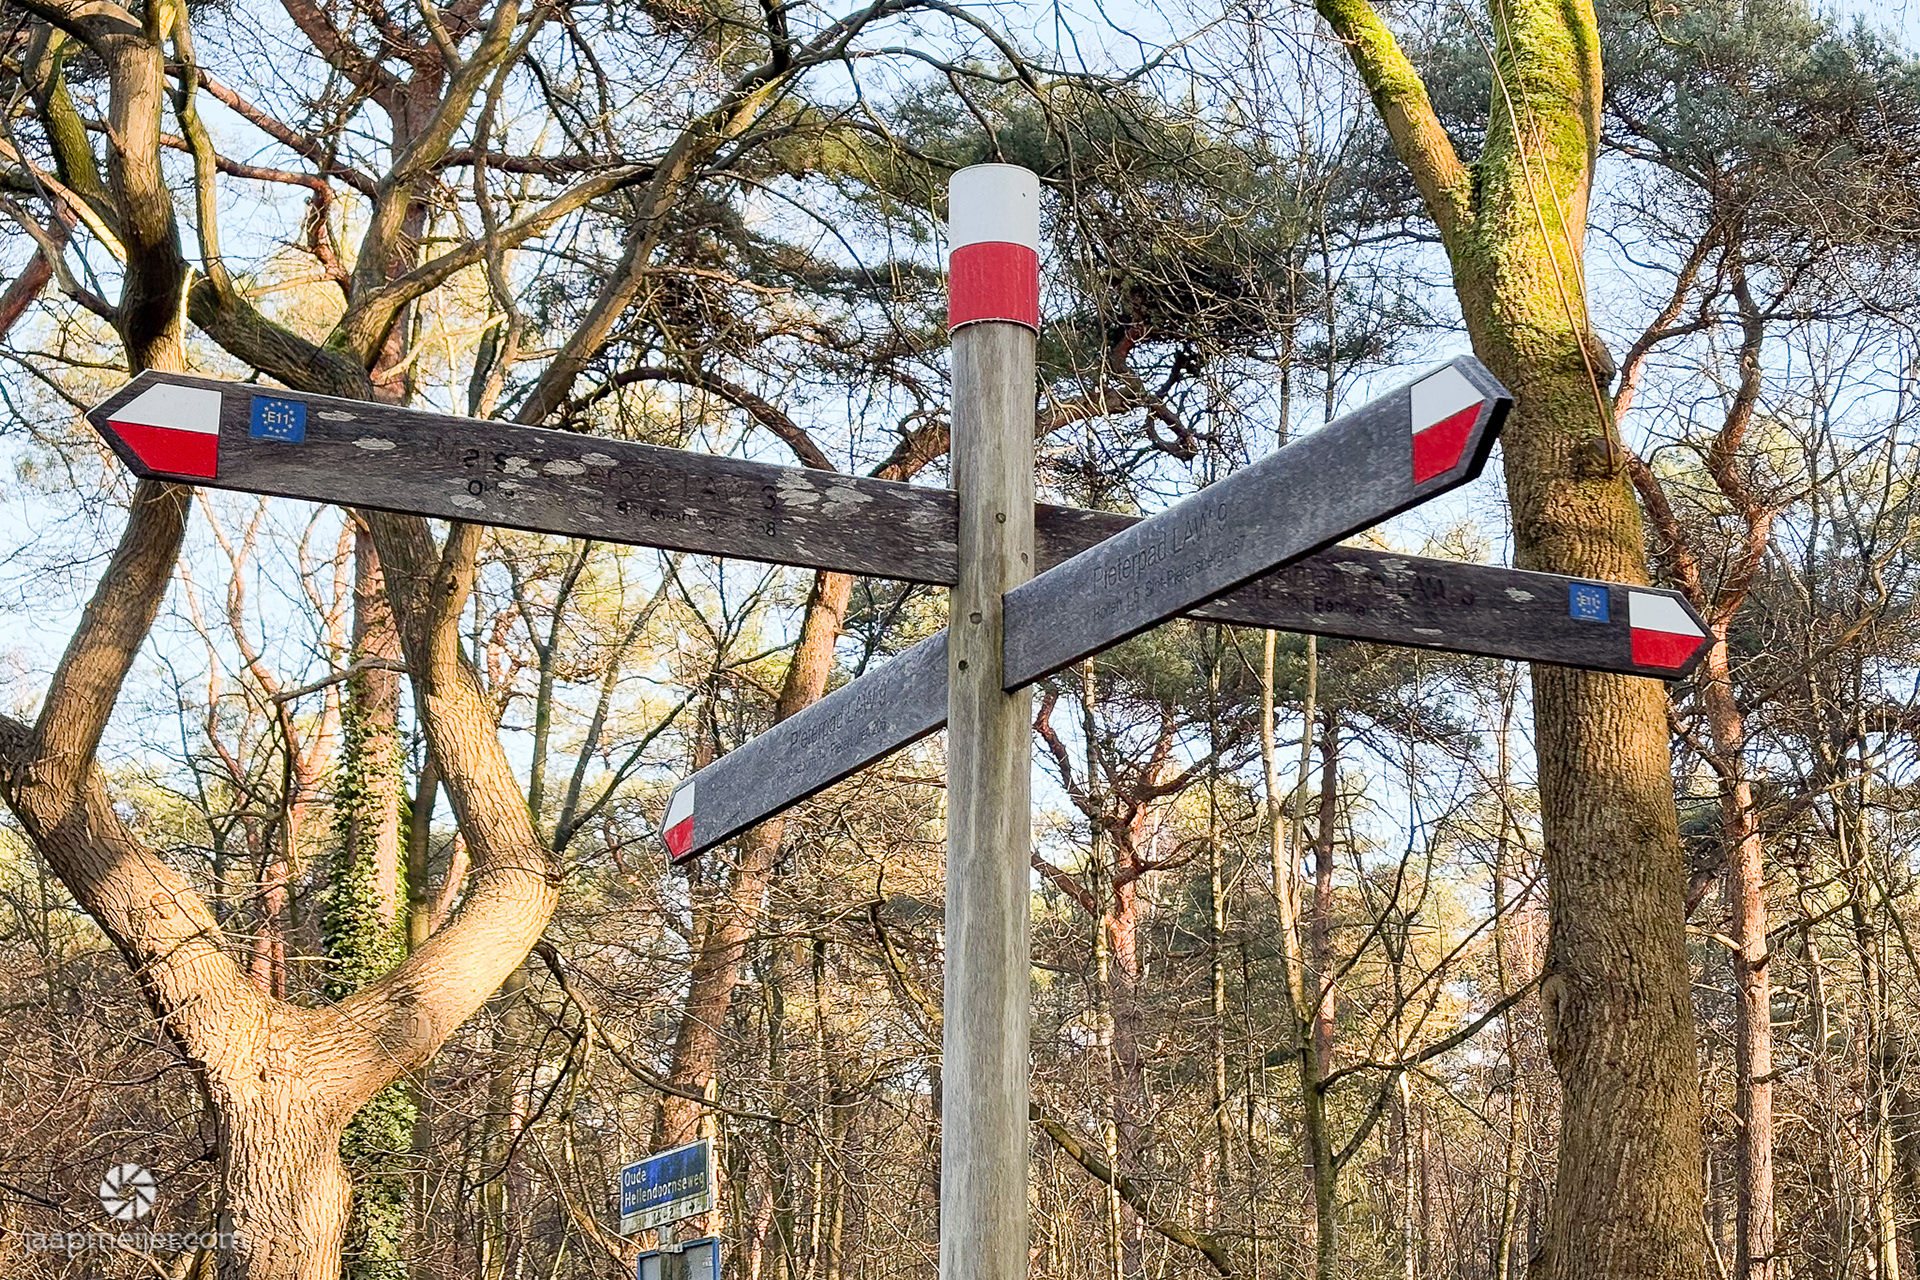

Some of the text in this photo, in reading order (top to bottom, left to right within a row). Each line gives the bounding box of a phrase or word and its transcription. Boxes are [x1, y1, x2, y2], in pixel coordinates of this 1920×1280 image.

[267, 411, 289, 425] E11
[761, 485, 777, 510] 3
[1092, 503, 1229, 593] Pieterpad LAW 9
[624, 1169, 647, 1187] Oude
[624, 1172, 704, 1208] Hellendoornseweg
